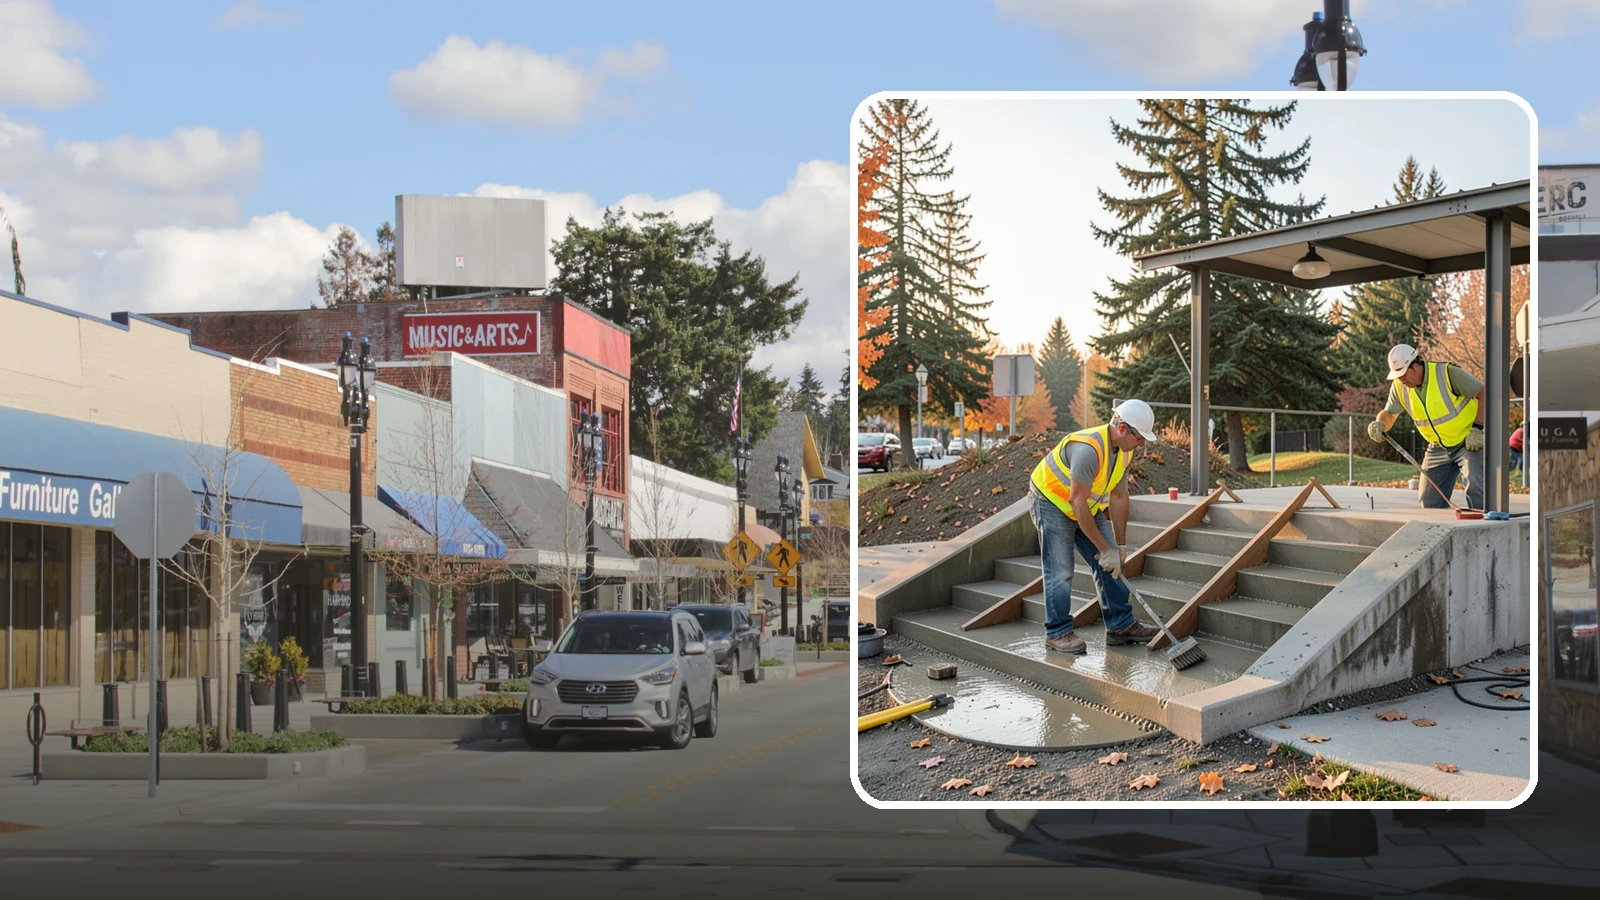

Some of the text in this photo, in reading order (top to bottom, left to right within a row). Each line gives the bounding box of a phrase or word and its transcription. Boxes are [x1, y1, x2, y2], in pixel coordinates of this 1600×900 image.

[1540, 427, 1577, 436] UGA
[0, 471, 121, 519] Furniture Gal
[453, 563, 479, 574] SUSHI
